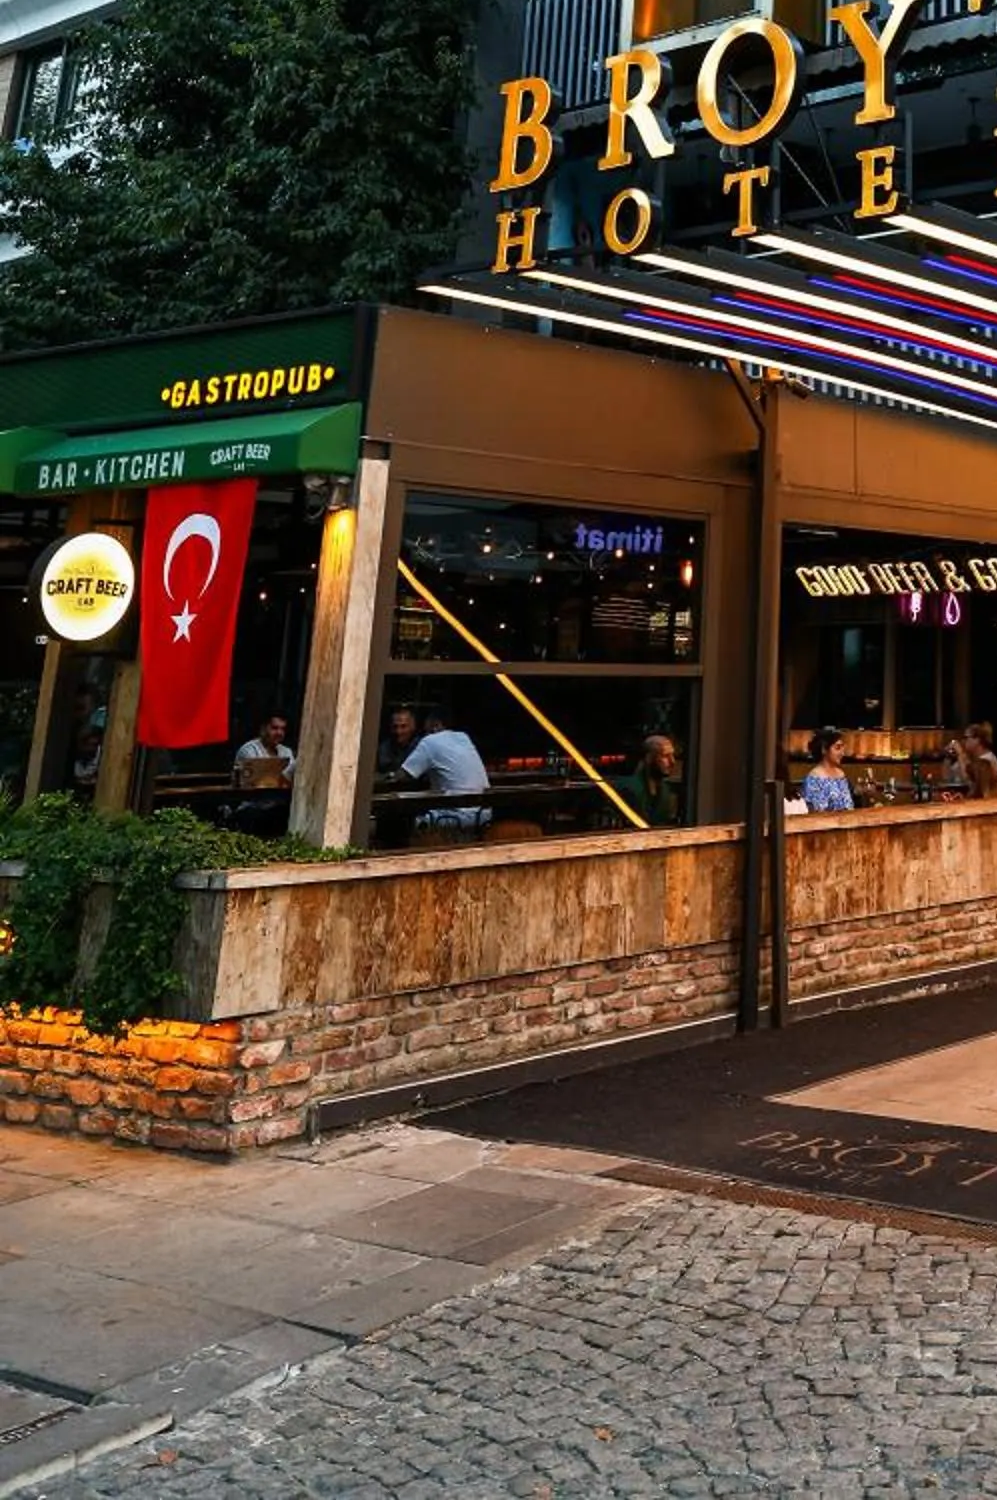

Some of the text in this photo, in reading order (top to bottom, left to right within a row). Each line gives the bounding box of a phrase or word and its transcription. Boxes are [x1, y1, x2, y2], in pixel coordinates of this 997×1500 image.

[171, 364, 323, 408] GASTROPUB
[38, 450, 186, 490] BAR KITCHEN
[209, 443, 271, 466] CRAFT BEER
[47, 577, 128, 598] CRAFT BEER
[940, 560, 972, 593] &
